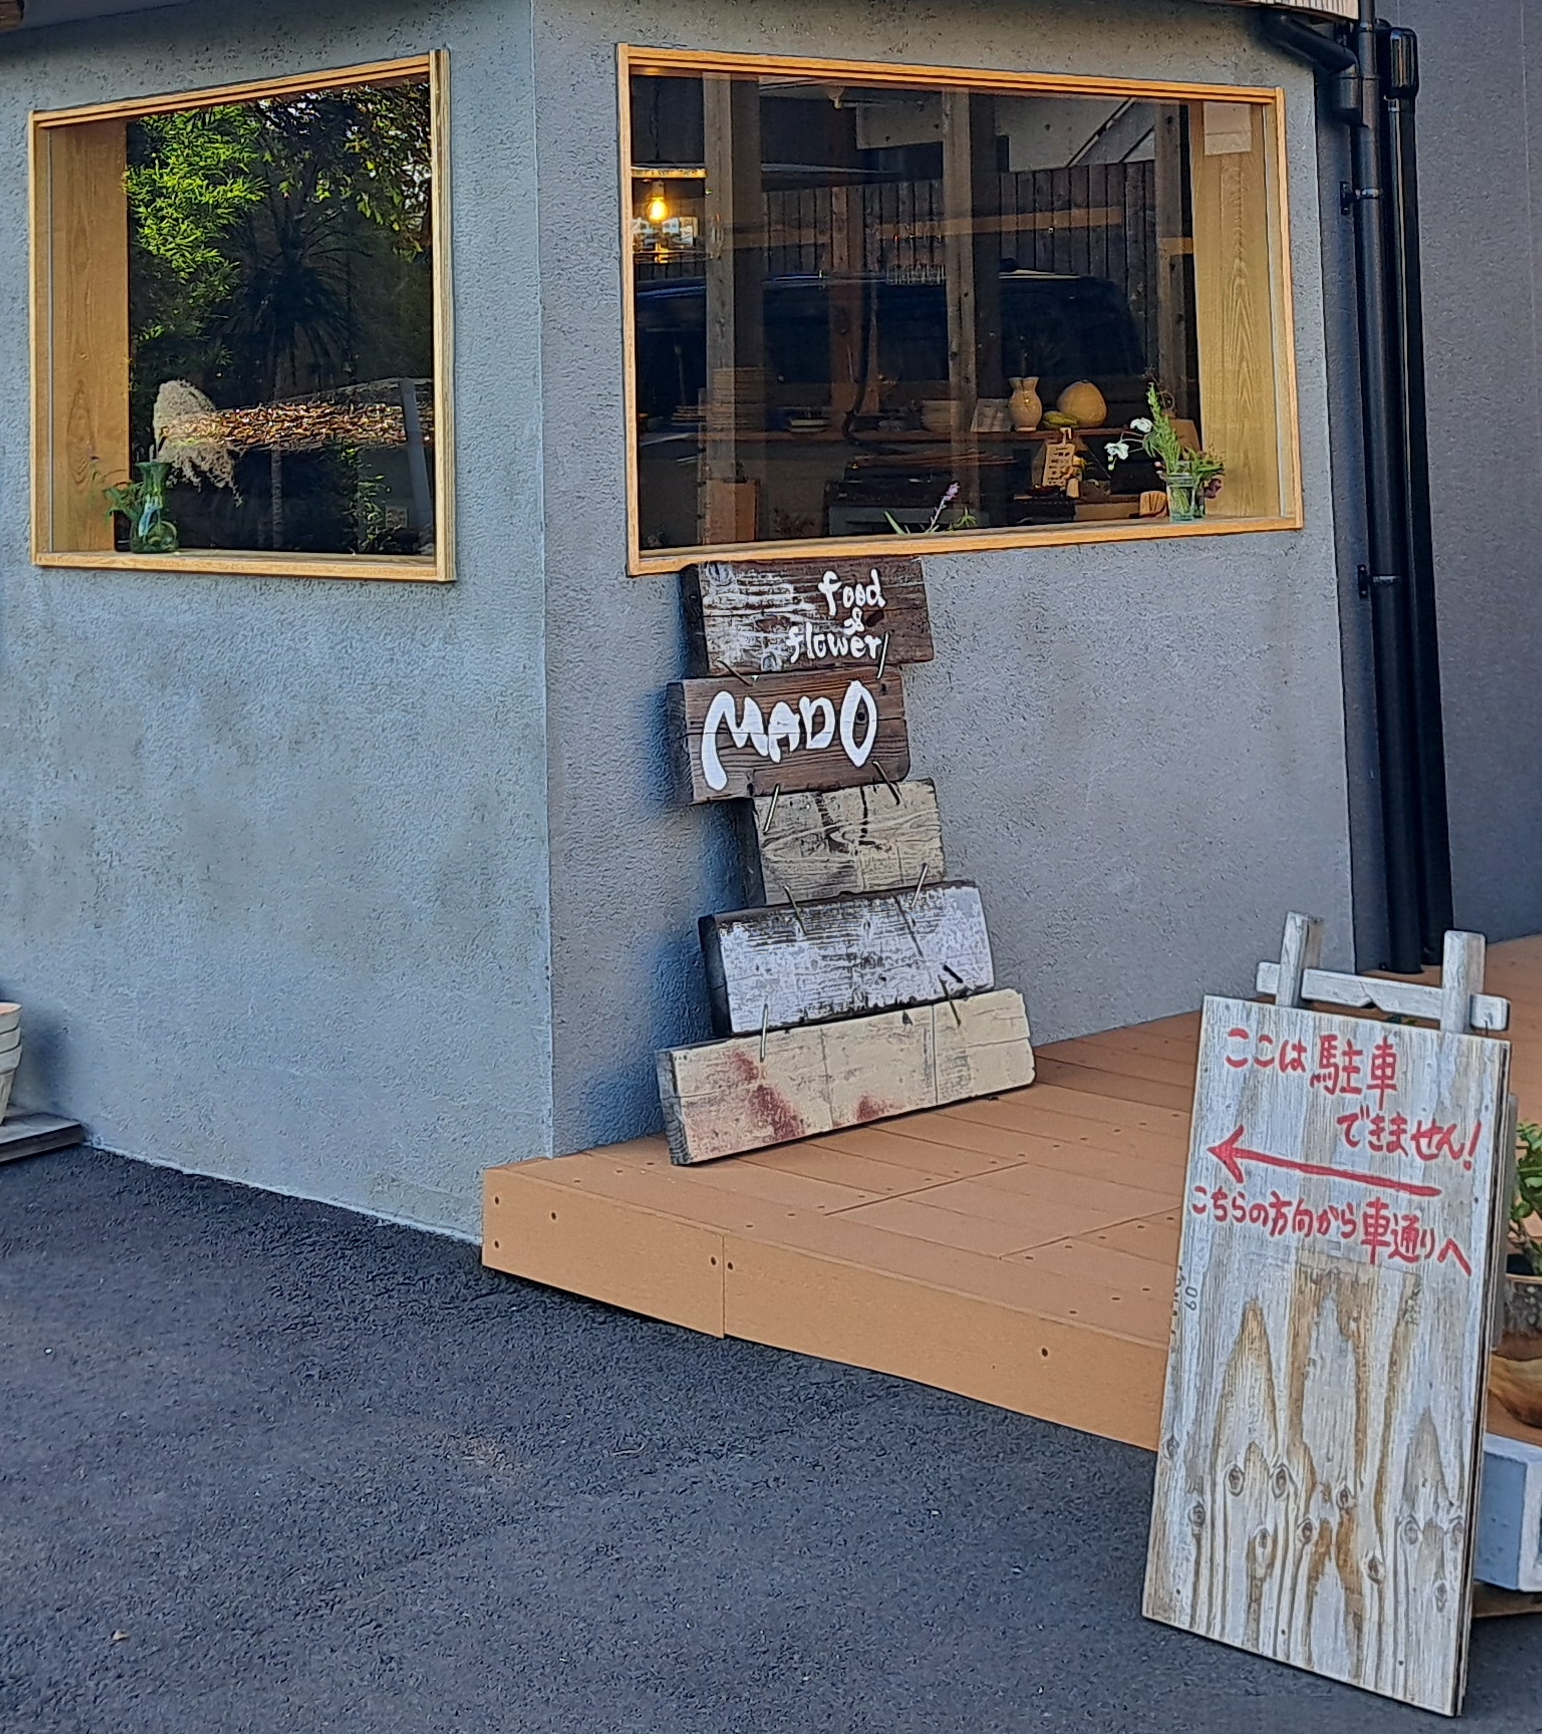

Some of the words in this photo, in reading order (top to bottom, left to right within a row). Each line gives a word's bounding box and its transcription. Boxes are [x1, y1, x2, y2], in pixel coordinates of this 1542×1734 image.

[817, 568, 887, 616] food
[844, 607, 865, 635] &
[785, 621, 882, 664] flower
[700, 679, 878, 791] MADO
[1225, 1027, 1398, 1112] ここは駐車
[1191, 1185, 1472, 1277] こちらの方向から車通りへ
